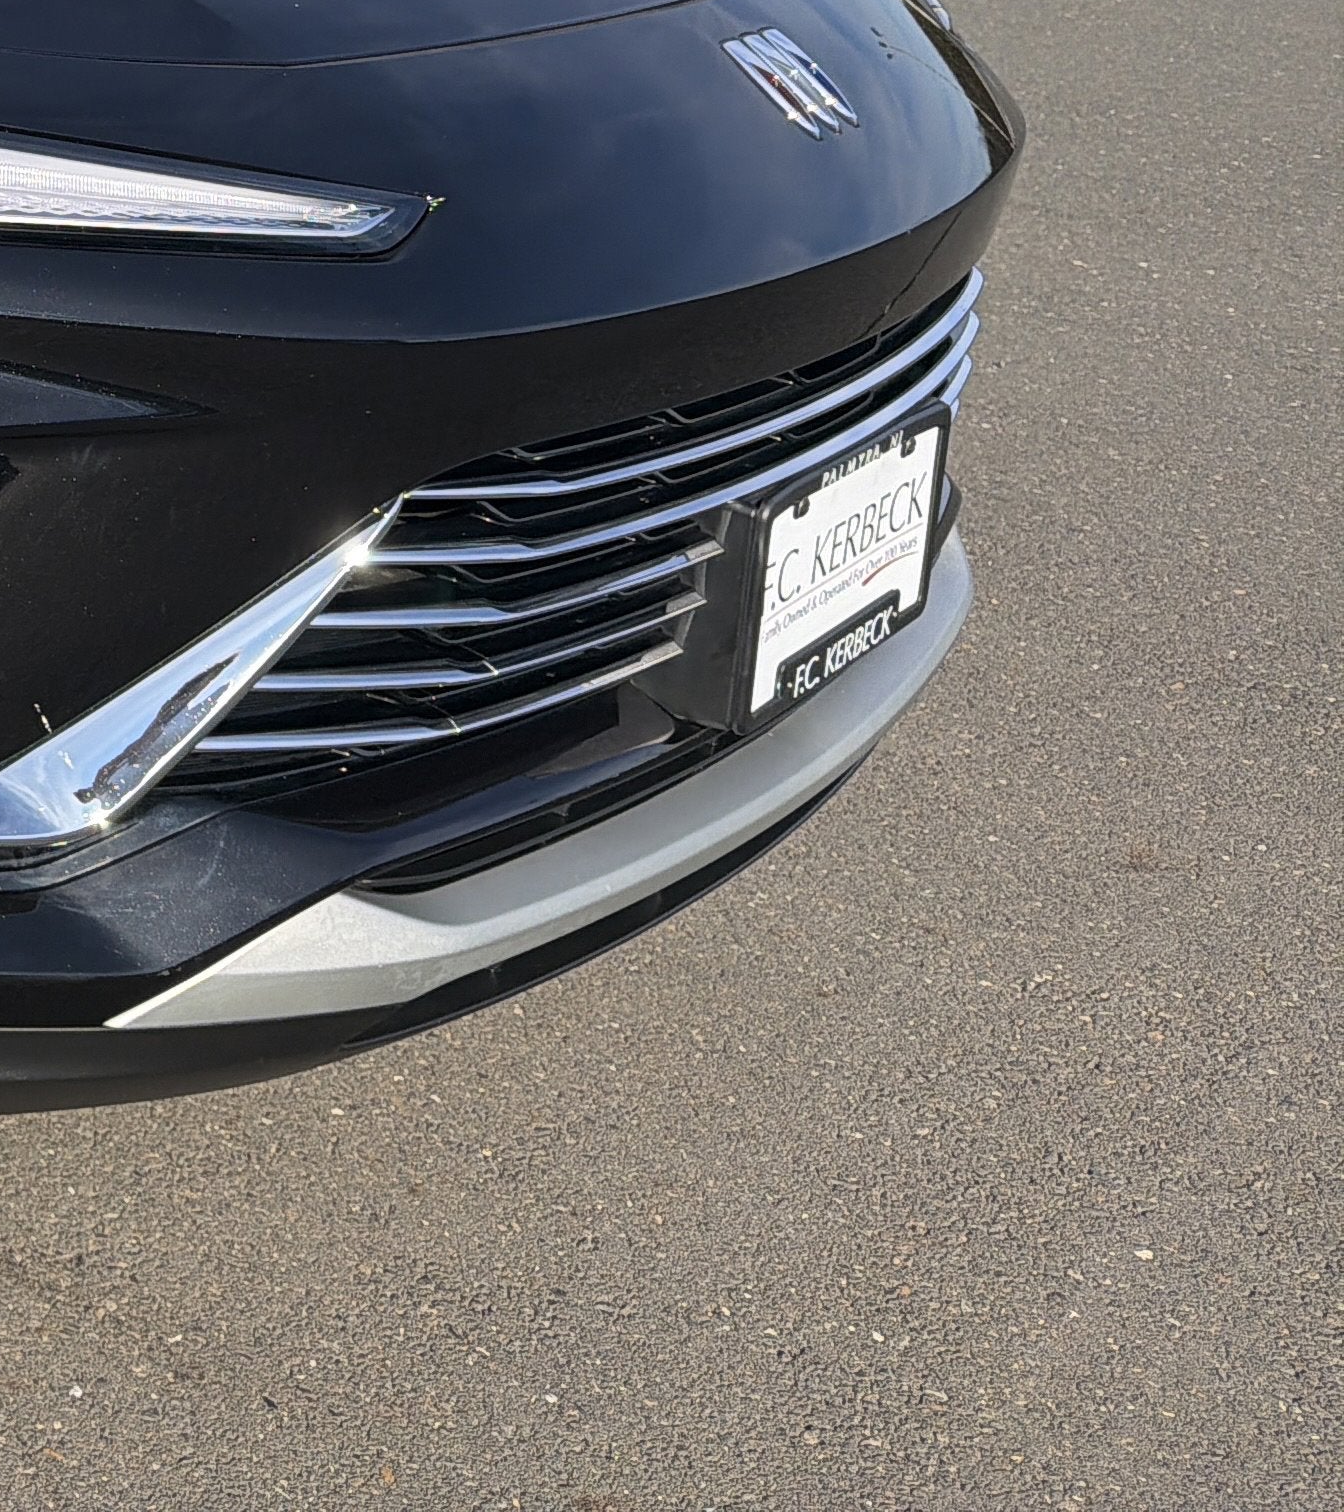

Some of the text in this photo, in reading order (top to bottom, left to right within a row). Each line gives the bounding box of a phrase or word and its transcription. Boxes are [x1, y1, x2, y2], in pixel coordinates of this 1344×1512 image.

[821, 444, 881, 489] PALMYRA
[811, 471, 927, 585] KERBECK
[823, 604, 894, 679] KERBECK
